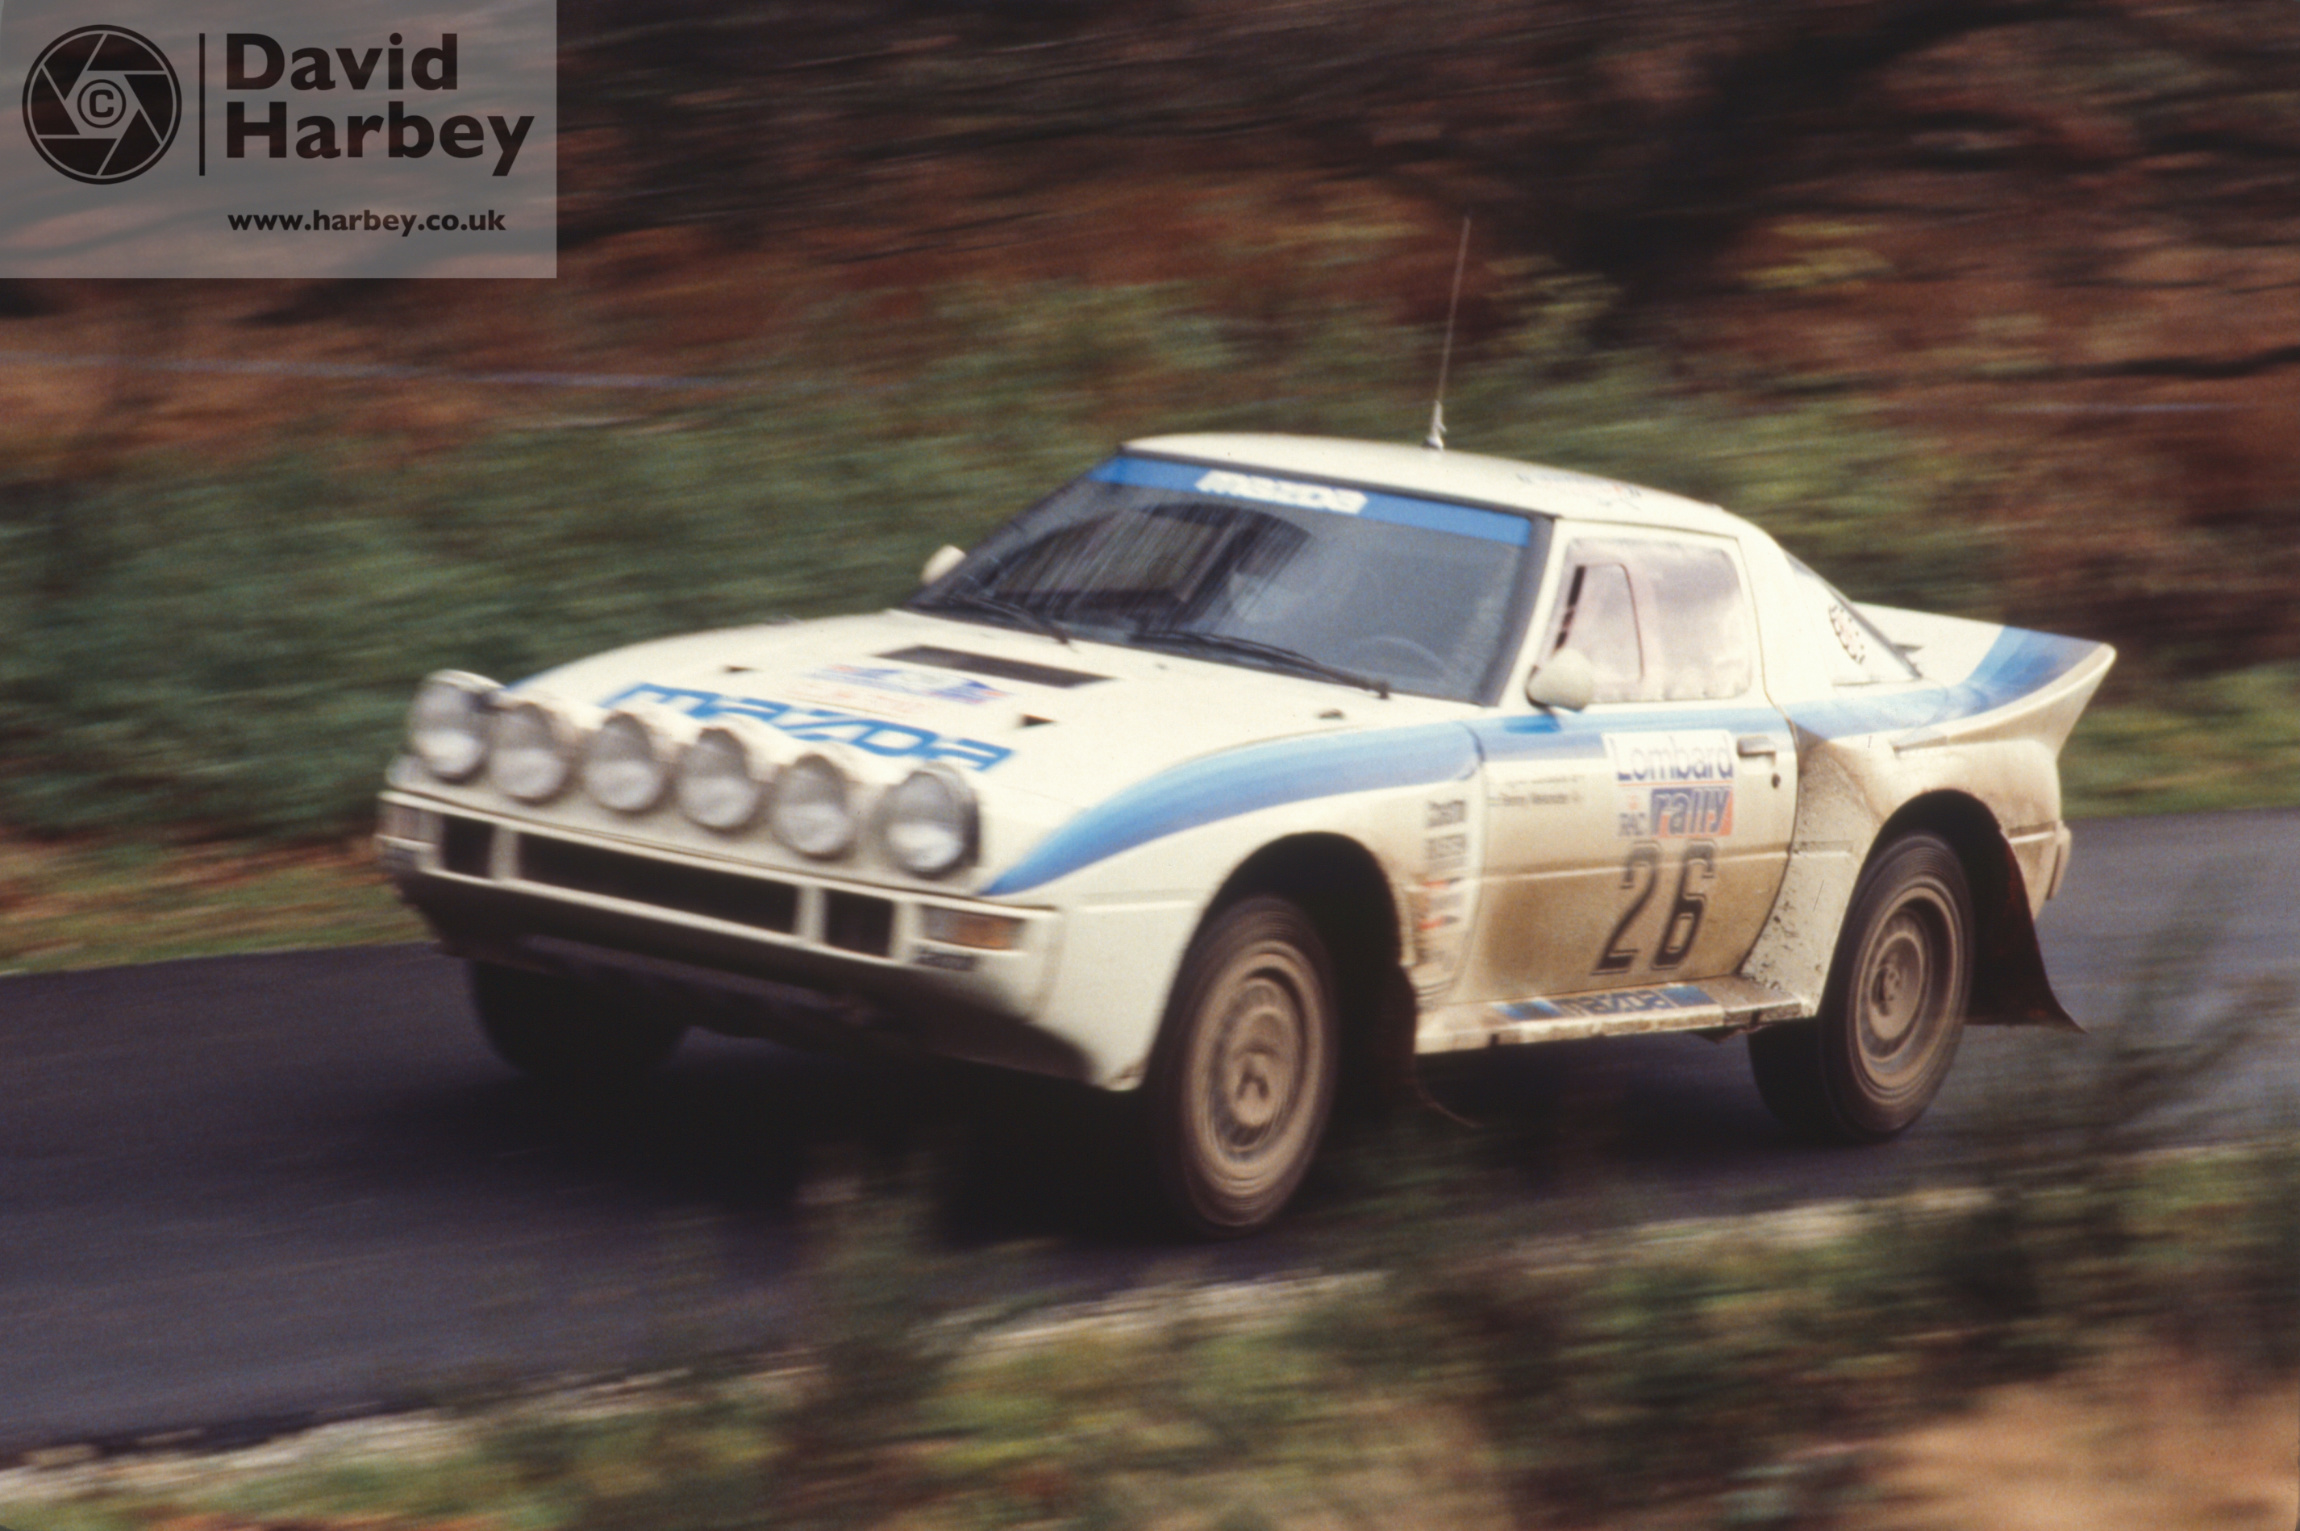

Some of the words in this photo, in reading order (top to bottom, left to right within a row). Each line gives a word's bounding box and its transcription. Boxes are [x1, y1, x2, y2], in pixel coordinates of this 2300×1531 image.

[1609, 735, 1733, 781] Lombard
[1650, 787, 1733, 836] rally
[1590, 839, 1717, 977] 26
